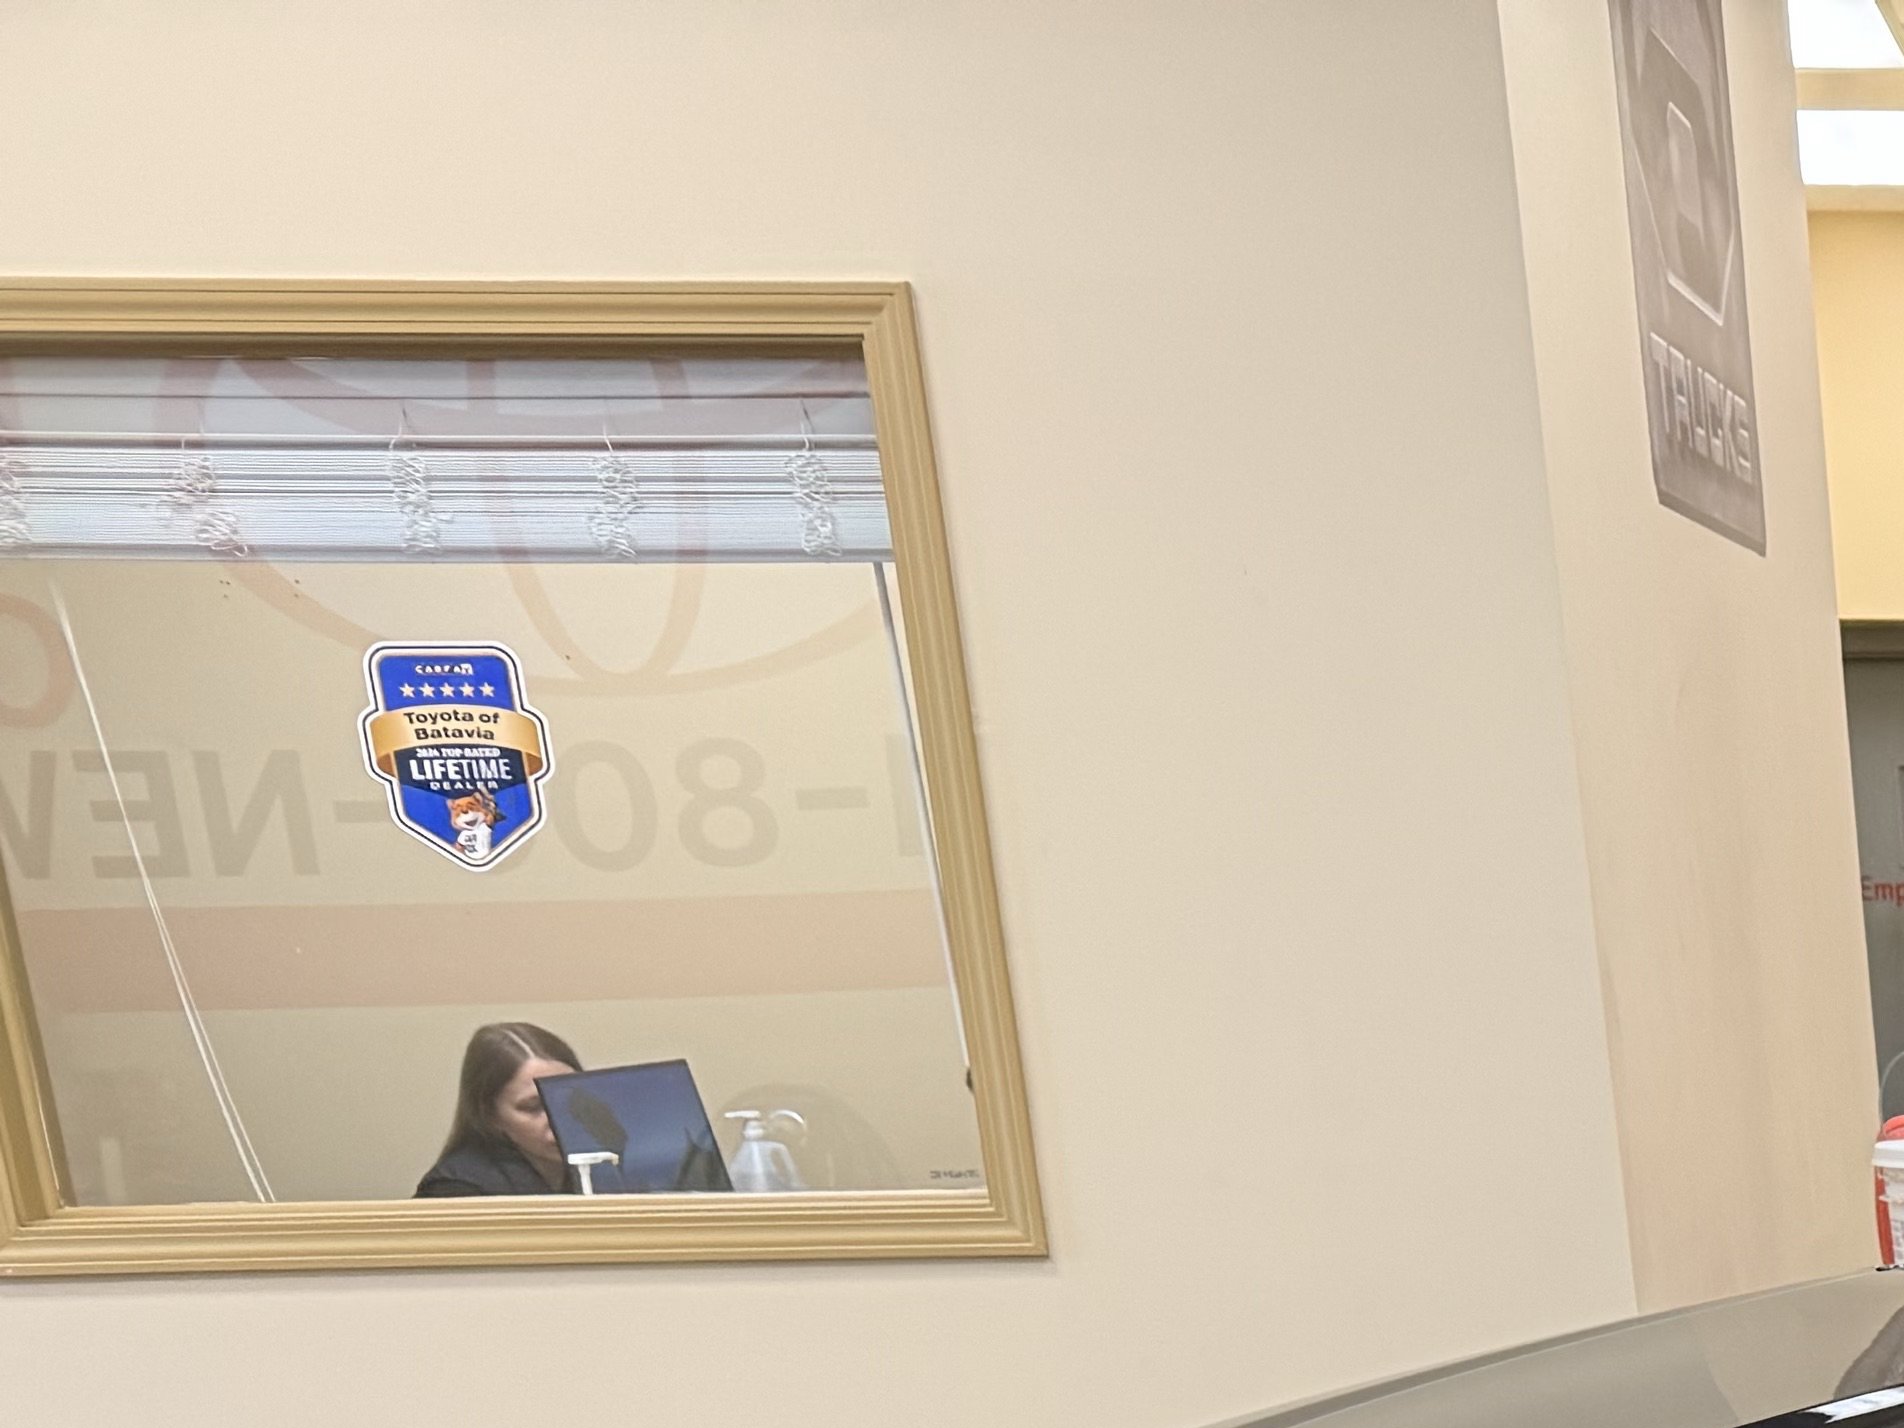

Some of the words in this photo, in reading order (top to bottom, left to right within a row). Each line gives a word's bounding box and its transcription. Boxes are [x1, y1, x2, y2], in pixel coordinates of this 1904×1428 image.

[1650, 332, 1754, 483] TRUCKS
[403, 709, 475, 726] Toyota
[479, 711, 501, 724] of
[414, 726, 495, 741] Batavia
[409, 758, 513, 781] LIFETIME
[430, 781, 499, 791] DEALER
